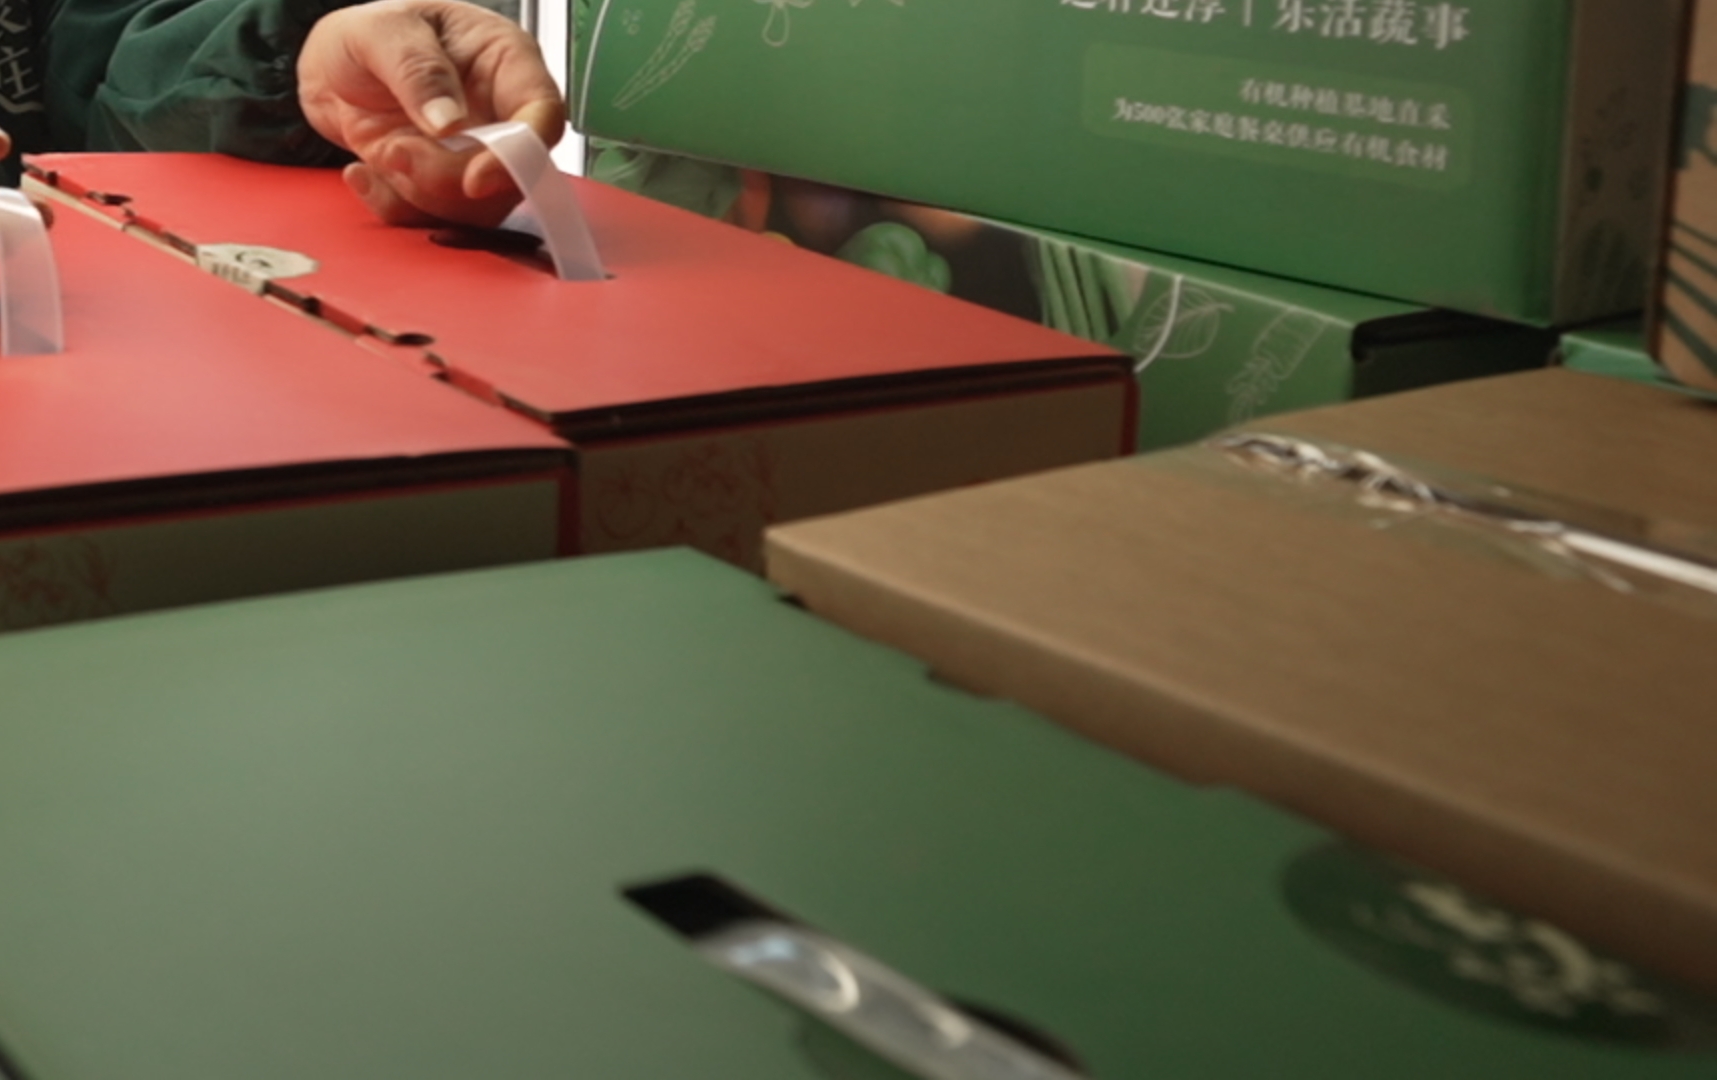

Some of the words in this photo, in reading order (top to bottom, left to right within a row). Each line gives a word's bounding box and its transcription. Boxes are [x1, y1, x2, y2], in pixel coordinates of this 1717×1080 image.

[1240, 77, 1452, 131] 有机种植基地直采
